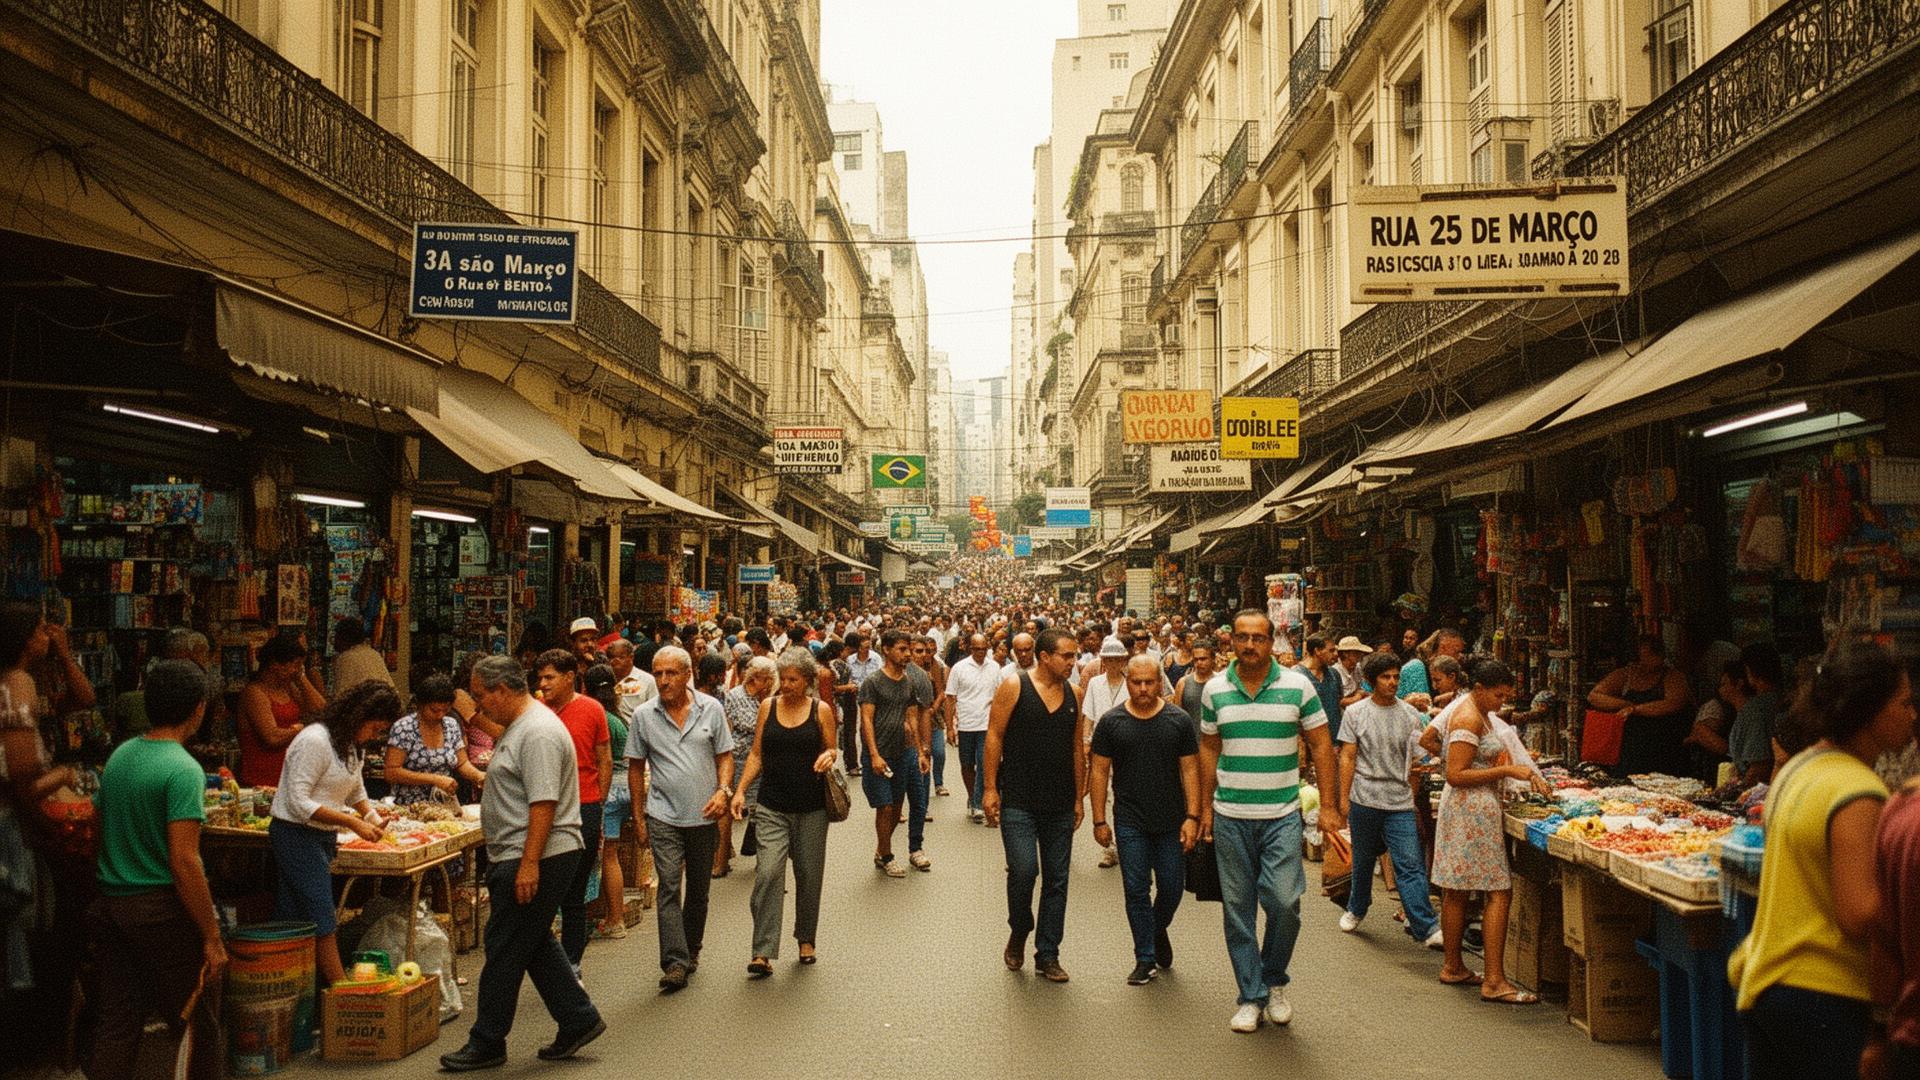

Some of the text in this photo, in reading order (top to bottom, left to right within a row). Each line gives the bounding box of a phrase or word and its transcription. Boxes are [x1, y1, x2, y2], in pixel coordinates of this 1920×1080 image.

[1371, 210, 1598, 249] RUA 25 DE MARÇO
[424, 249, 452, 271] 3A
[1582, 249, 1598, 265] 20
